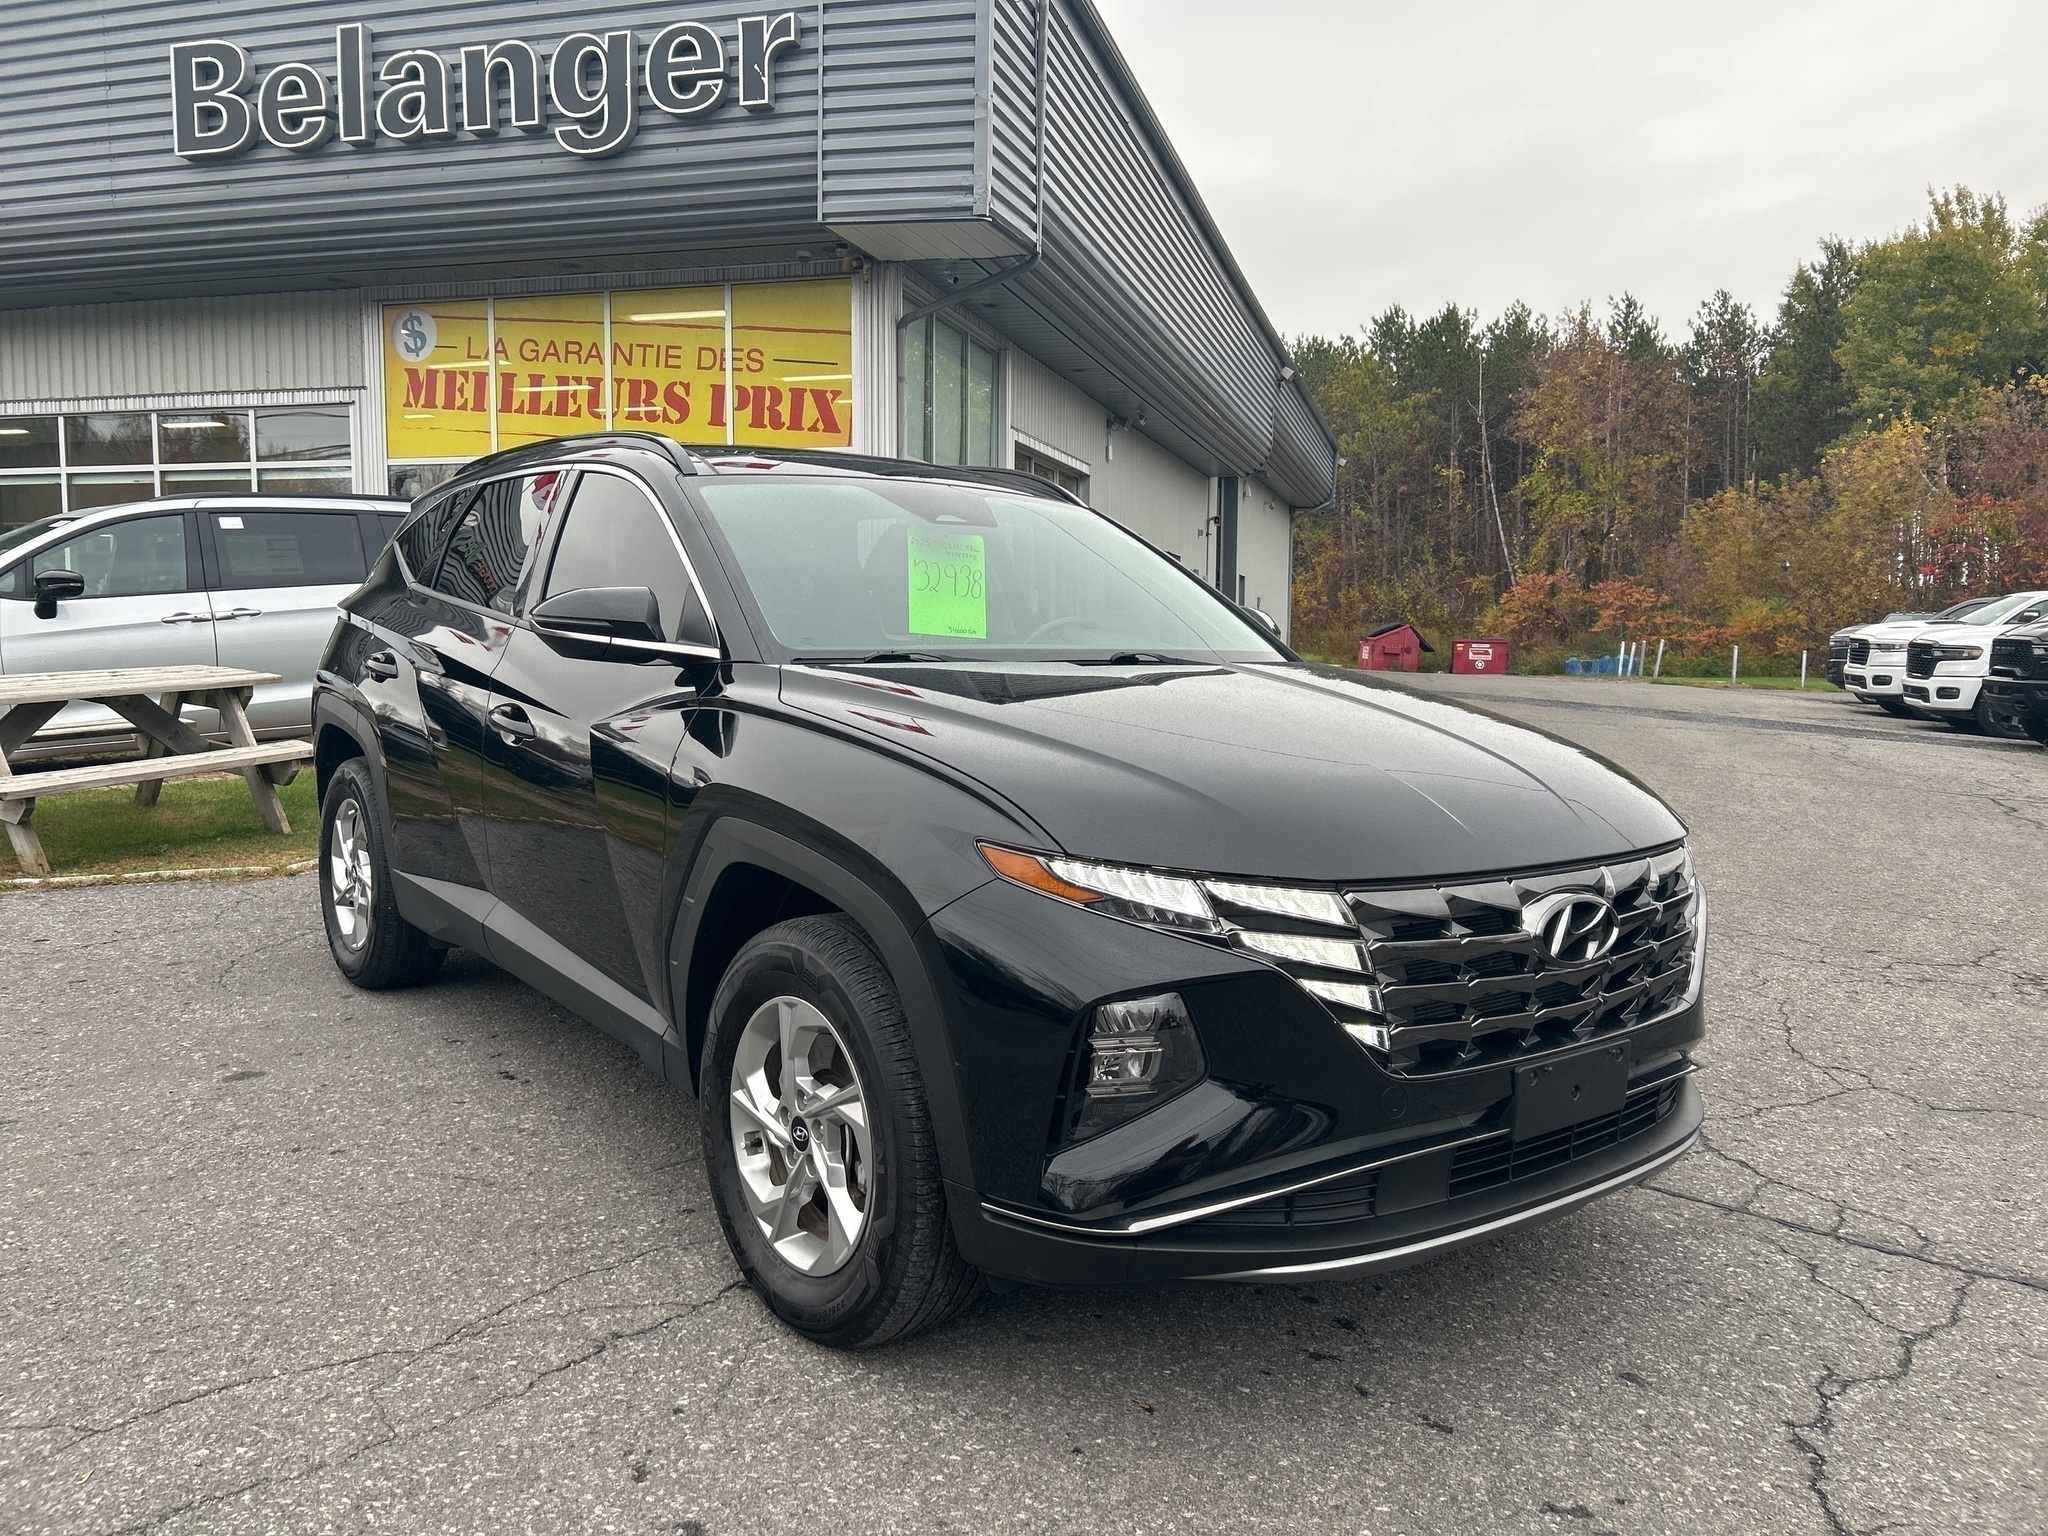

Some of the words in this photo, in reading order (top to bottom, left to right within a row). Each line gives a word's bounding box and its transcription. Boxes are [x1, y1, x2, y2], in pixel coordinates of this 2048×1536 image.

[169, 11, 804, 160] Belanger
[466, 336, 510, 361] LA
[519, 338, 682, 370] GARANTIE
[696, 345, 765, 373] DES
[402, 367, 691, 425] MEILLEURS
[707, 383, 843, 434] PRIX
